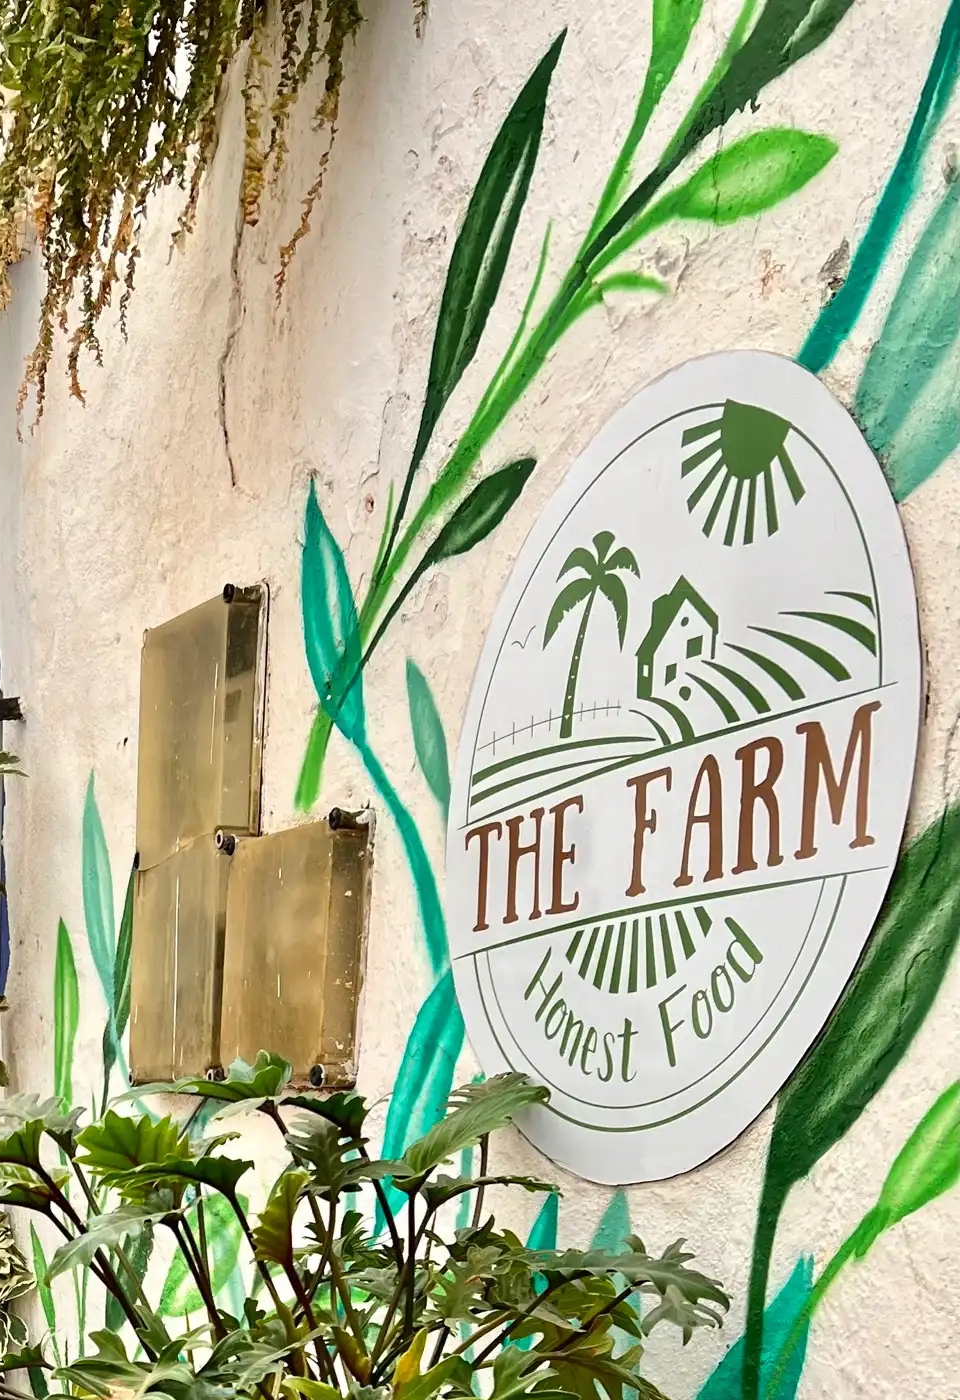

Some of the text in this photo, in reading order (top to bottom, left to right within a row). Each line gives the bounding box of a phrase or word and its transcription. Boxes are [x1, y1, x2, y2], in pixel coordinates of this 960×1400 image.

[465, 701, 882, 932] THE FARM
[524, 917, 763, 1082] Honest Food
